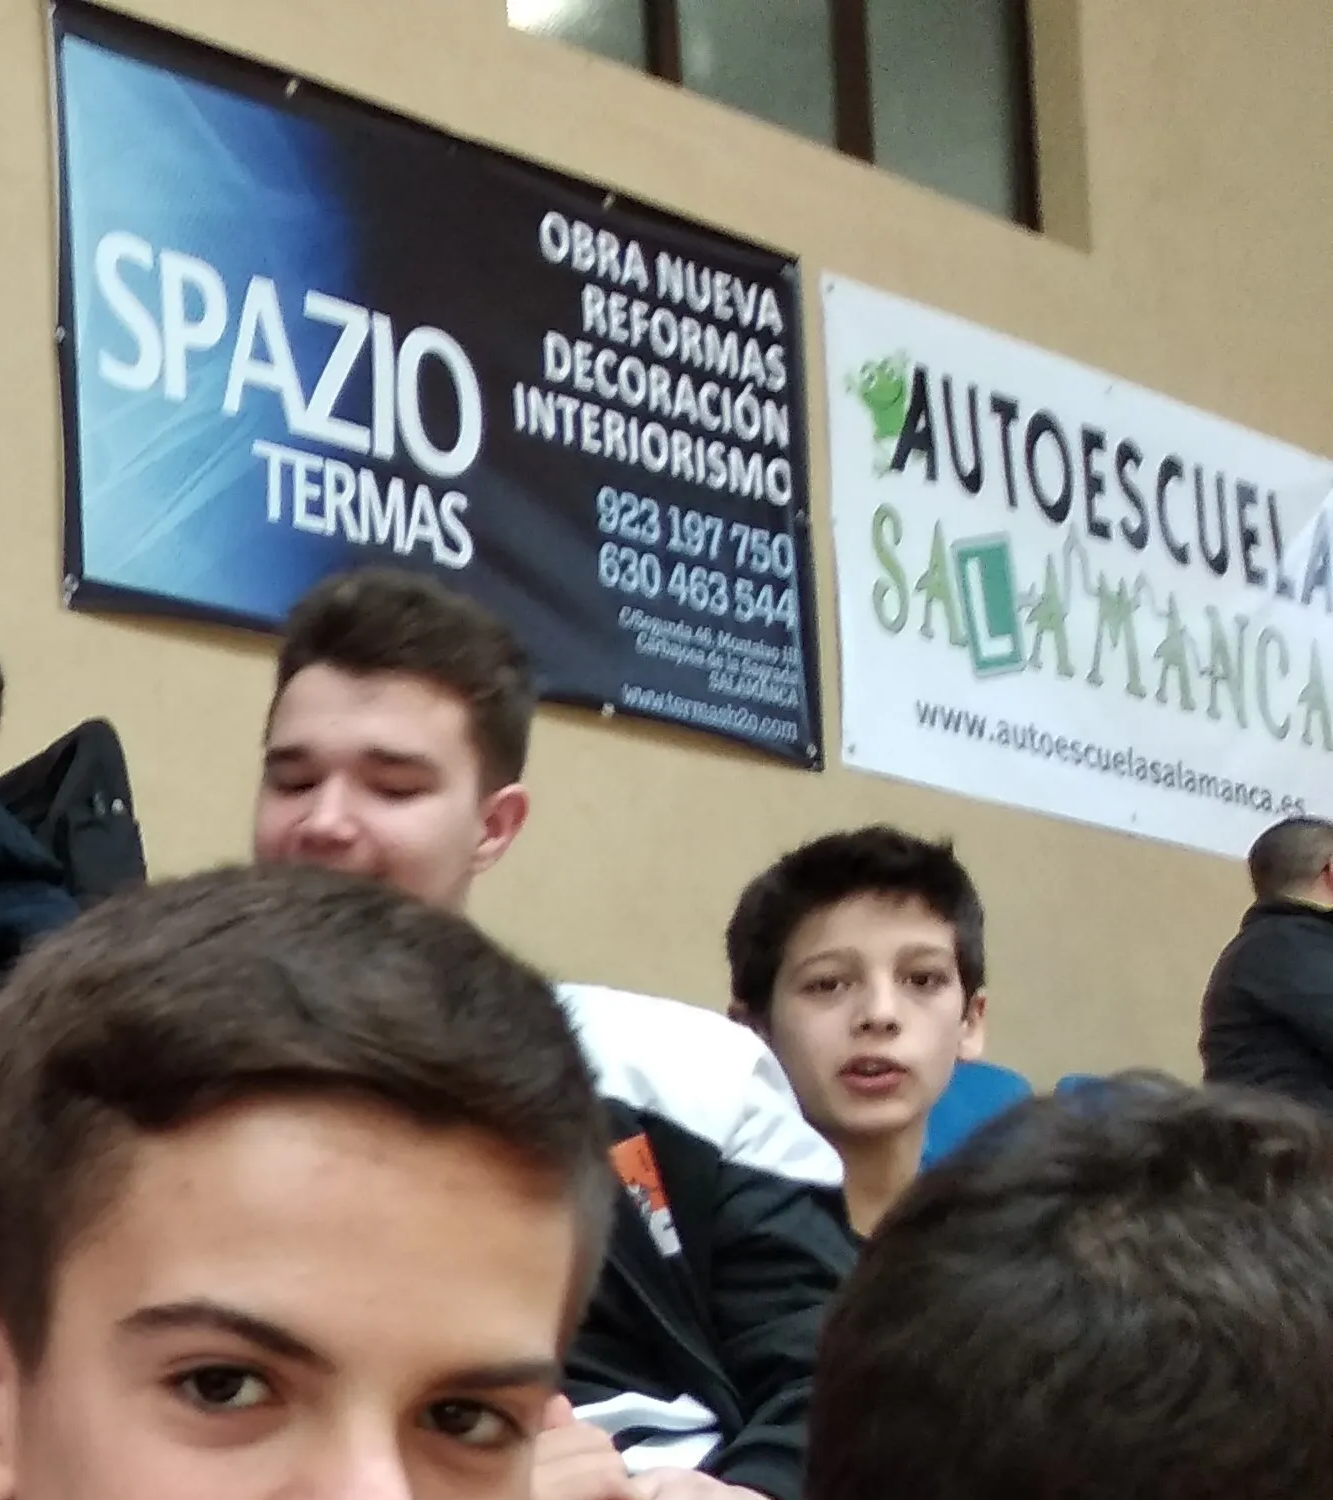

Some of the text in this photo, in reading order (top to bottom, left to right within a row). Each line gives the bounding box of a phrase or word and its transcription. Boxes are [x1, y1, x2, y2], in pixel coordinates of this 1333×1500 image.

[539, 211, 783, 337] OBRA NUEVA
[94, 230, 483, 478] SPAZIO
[543, 330, 790, 449] DECORACIÓN
[581, 282, 787, 393] REFORMAS
[252, 438, 474, 570] TERMAS
[513, 381, 792, 506] INTERIORISMO
[890, 363, 1333, 614] AUTOESCUELA
[596, 486, 794, 578] 923 197 750
[597, 541, 799, 629] 630 463 544
[871, 502, 1333, 752] SALAMANCA
[915, 698, 1306, 816] www.autoescuelasalamanca.es
